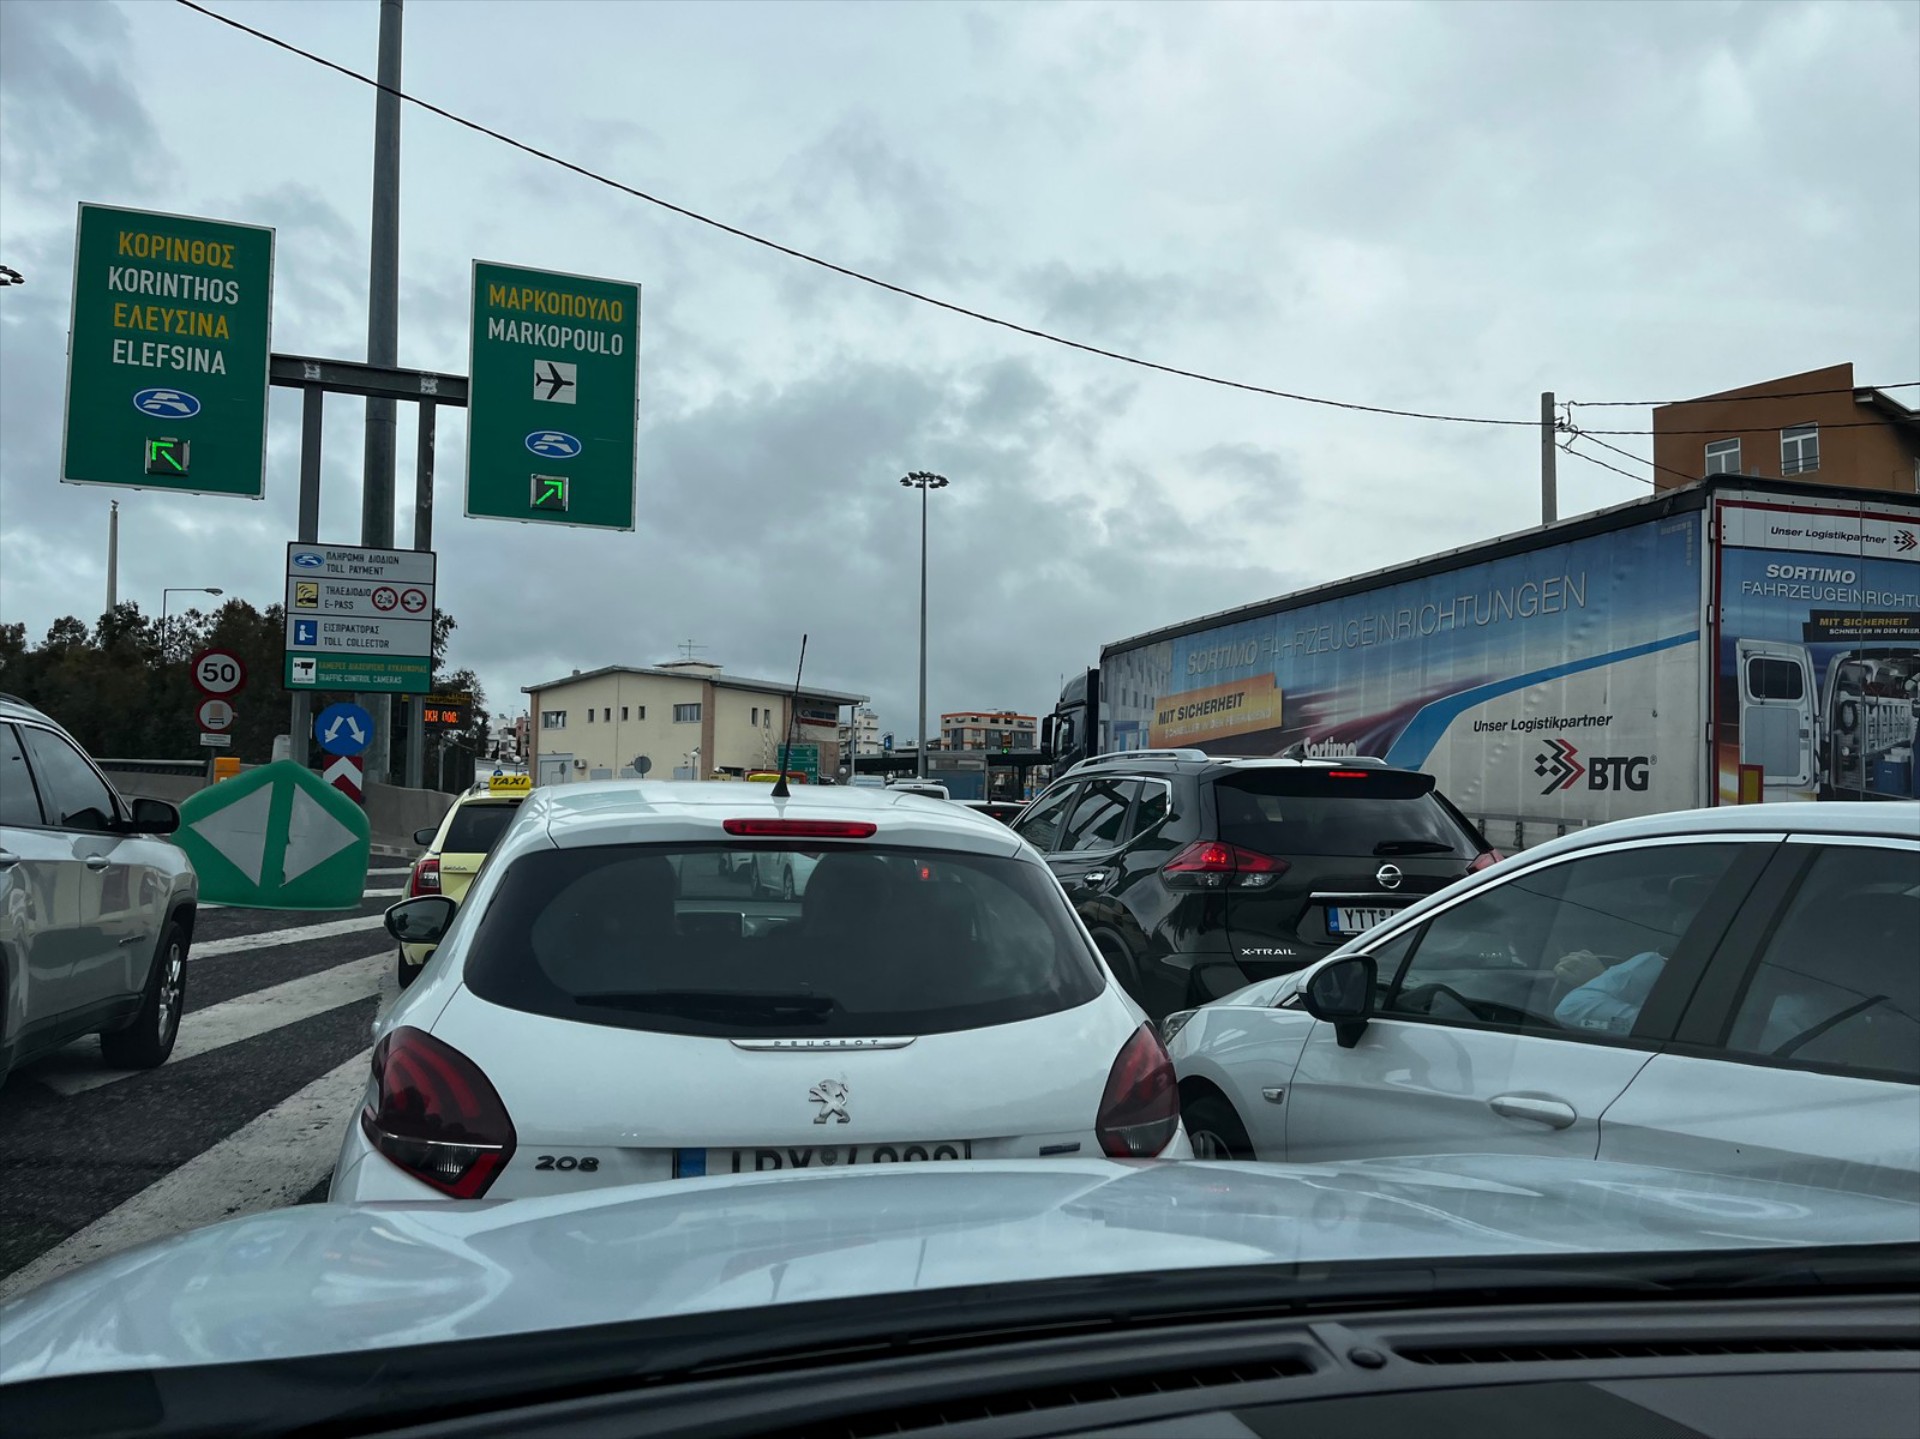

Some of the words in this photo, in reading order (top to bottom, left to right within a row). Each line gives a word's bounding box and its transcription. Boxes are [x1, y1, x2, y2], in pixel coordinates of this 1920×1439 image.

[118, 231, 235, 269] ΚΟΡΙΝΘΟΣ
[108, 265, 240, 305] KORINTHOS
[488, 284, 623, 323] ΜΑΡΚΟΠΟΥΛΟ
[113, 302, 230, 339] ΕΛΕΥΣΙΝΑ
[487, 316, 623, 356] MARKOPOULO
[112, 338, 227, 375] ELEFSINA
[1770, 526, 1803, 537] Unser
[1805, 528, 1887, 545] Logistikpartner
[326, 551, 365, 562] ΠΛΗΡΩΜΗ
[368, 555, 399, 565] ΔΙΟΔΙΩΝ
[326, 563, 345, 574] TOLL
[348, 565, 384, 576] PAYMENT
[1766, 564, 1856, 584] SORTIMO
[324, 599, 354, 610] E-PASS
[1819, 617, 1841, 626] MIT
[1843, 617, 1910, 627] SICHERHEIT
[1874, 627, 1882, 635] IN
[1883, 627, 1898, 635] DEN
[1899, 627, 1920, 635] FEIER
[324, 636, 343, 647] TOLL
[346, 638, 390, 649] COLLECTOR
[1186, 640, 1259, 676] SORTIMO
[202, 662, 236, 683] 50
[373, 676, 402, 684] CAMERAS
[1158, 709, 1175, 725] MIT
[1177, 692, 1245, 721] SICHERHEIT
[1473, 720, 1508, 732] Unser
[1511, 714, 1613, 733] Logistikpartner
[492, 777, 527, 786] TAXI
[1588, 756, 1649, 791] BTG
[1241, 948, 1297, 956] X-TRAIL
[773, 1039, 878, 1048] PEUGEOT
[534, 1155, 600, 1173] 208
